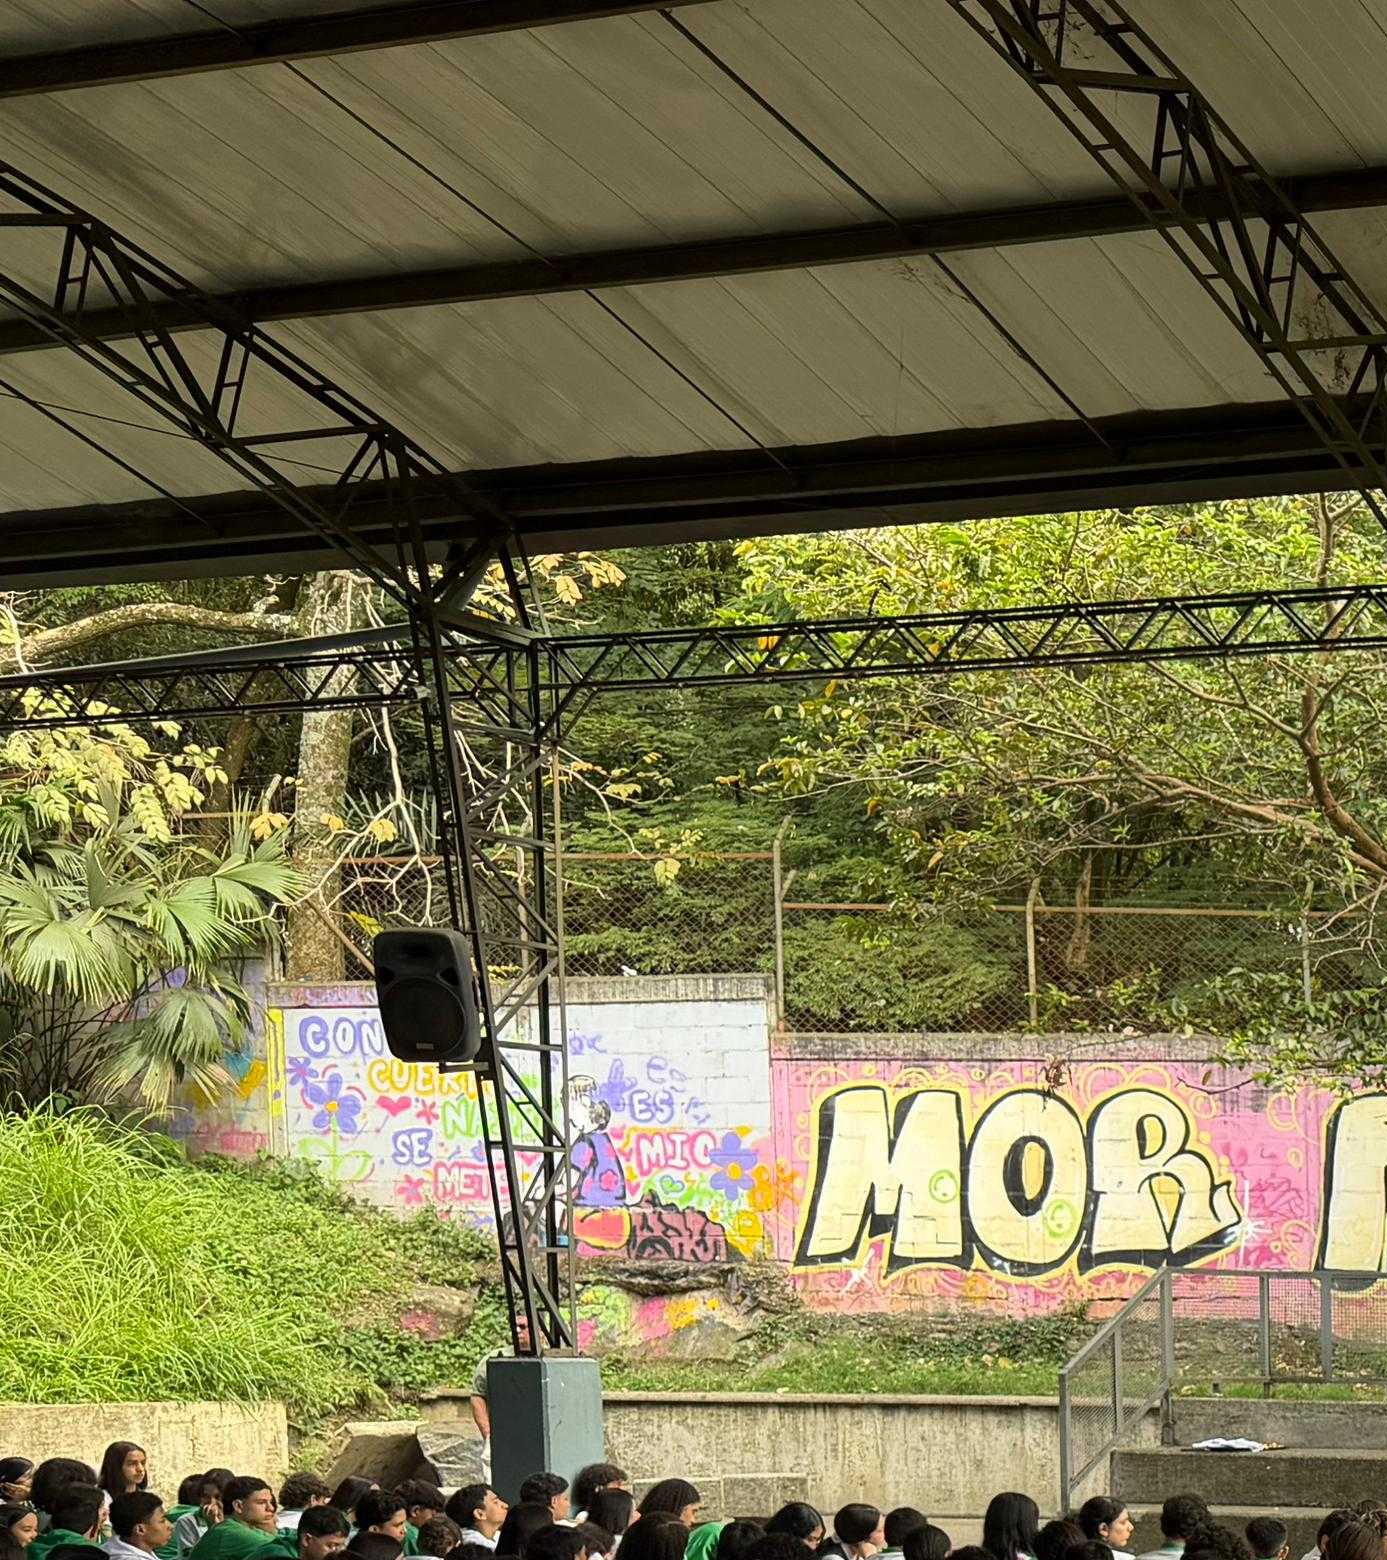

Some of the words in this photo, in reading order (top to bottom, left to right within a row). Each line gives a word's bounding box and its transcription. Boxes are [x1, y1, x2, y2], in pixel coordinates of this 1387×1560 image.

[630, 1090, 674, 1124] ES
[392, 1127, 433, 1166] SE
[798, 1086, 1241, 1276] MOR
